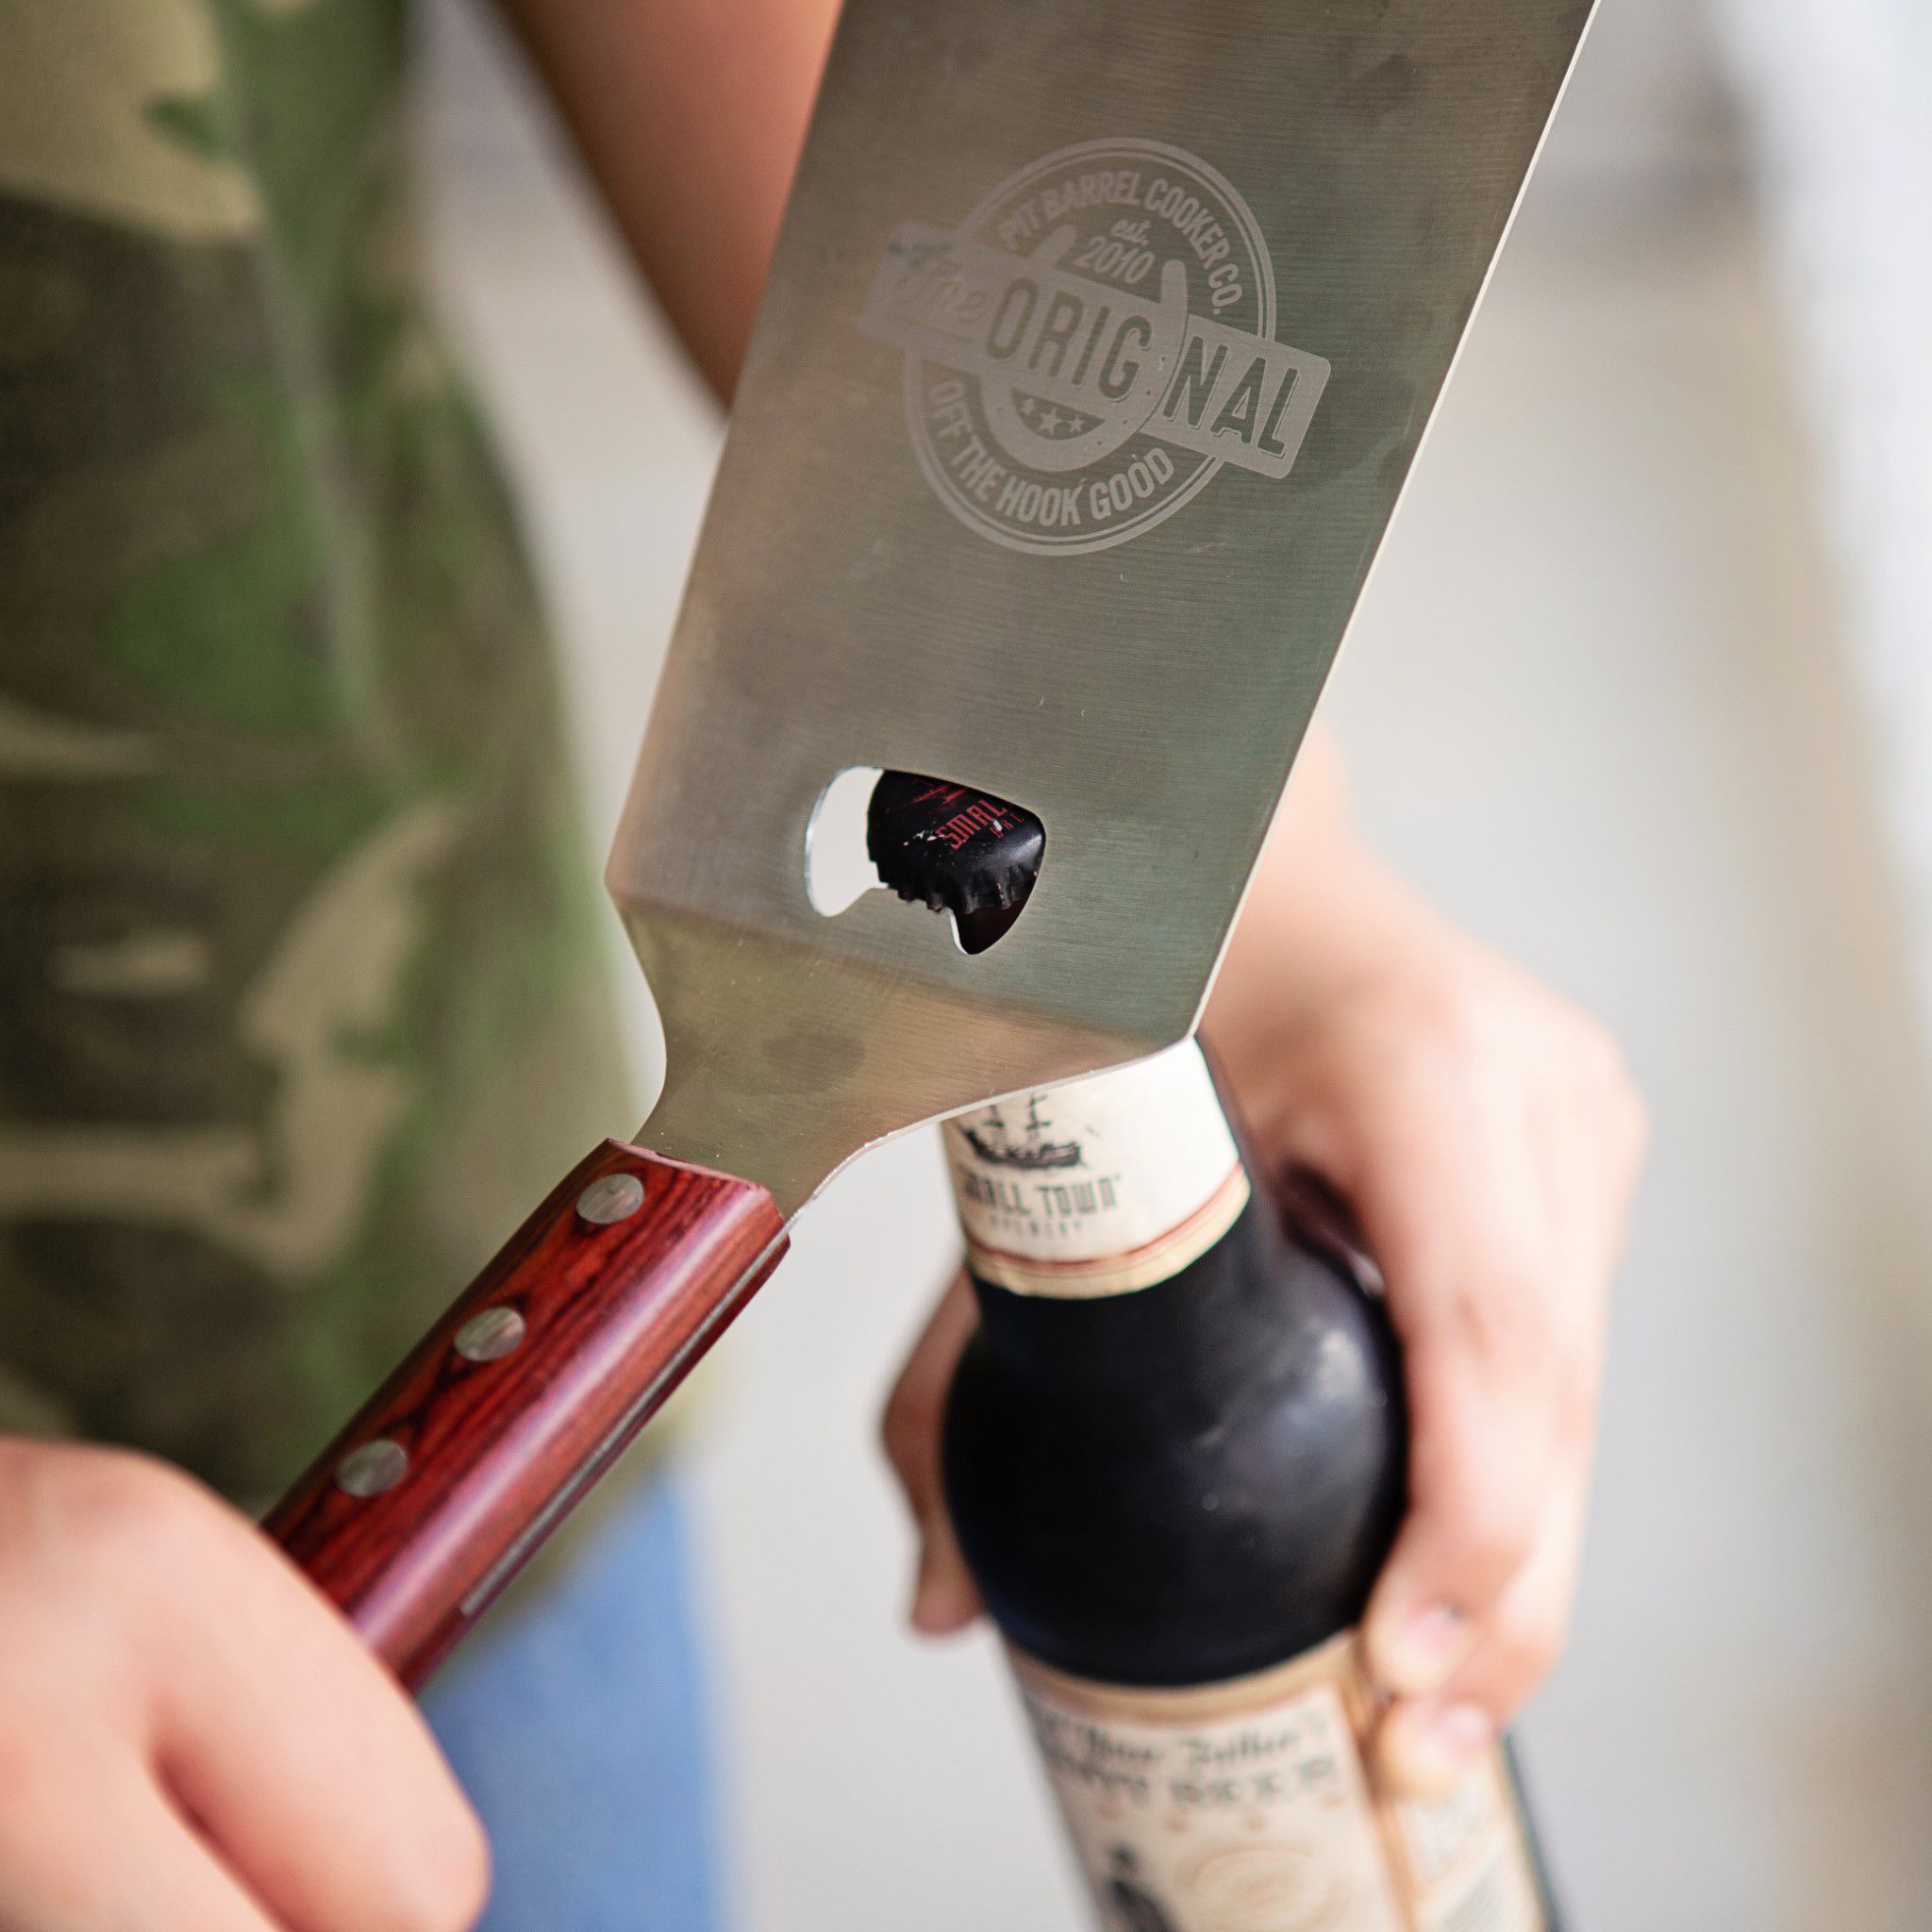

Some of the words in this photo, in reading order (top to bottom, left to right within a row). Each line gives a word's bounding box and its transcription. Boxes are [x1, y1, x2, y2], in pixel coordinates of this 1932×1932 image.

[1041, 169, 1142, 223] BARREL
[1146, 177, 1230, 271] COOKER
[1072, 234, 1157, 285] 2010
[928, 379, 975, 440] OFF
[949, 434, 1007, 503] THE
[1089, 447, 1175, 522] GOOD
[994, 475, 1084, 527] HOOK
[935, 798, 1008, 850] SMAL
[1035, 1175, 1119, 1218] TOWN
